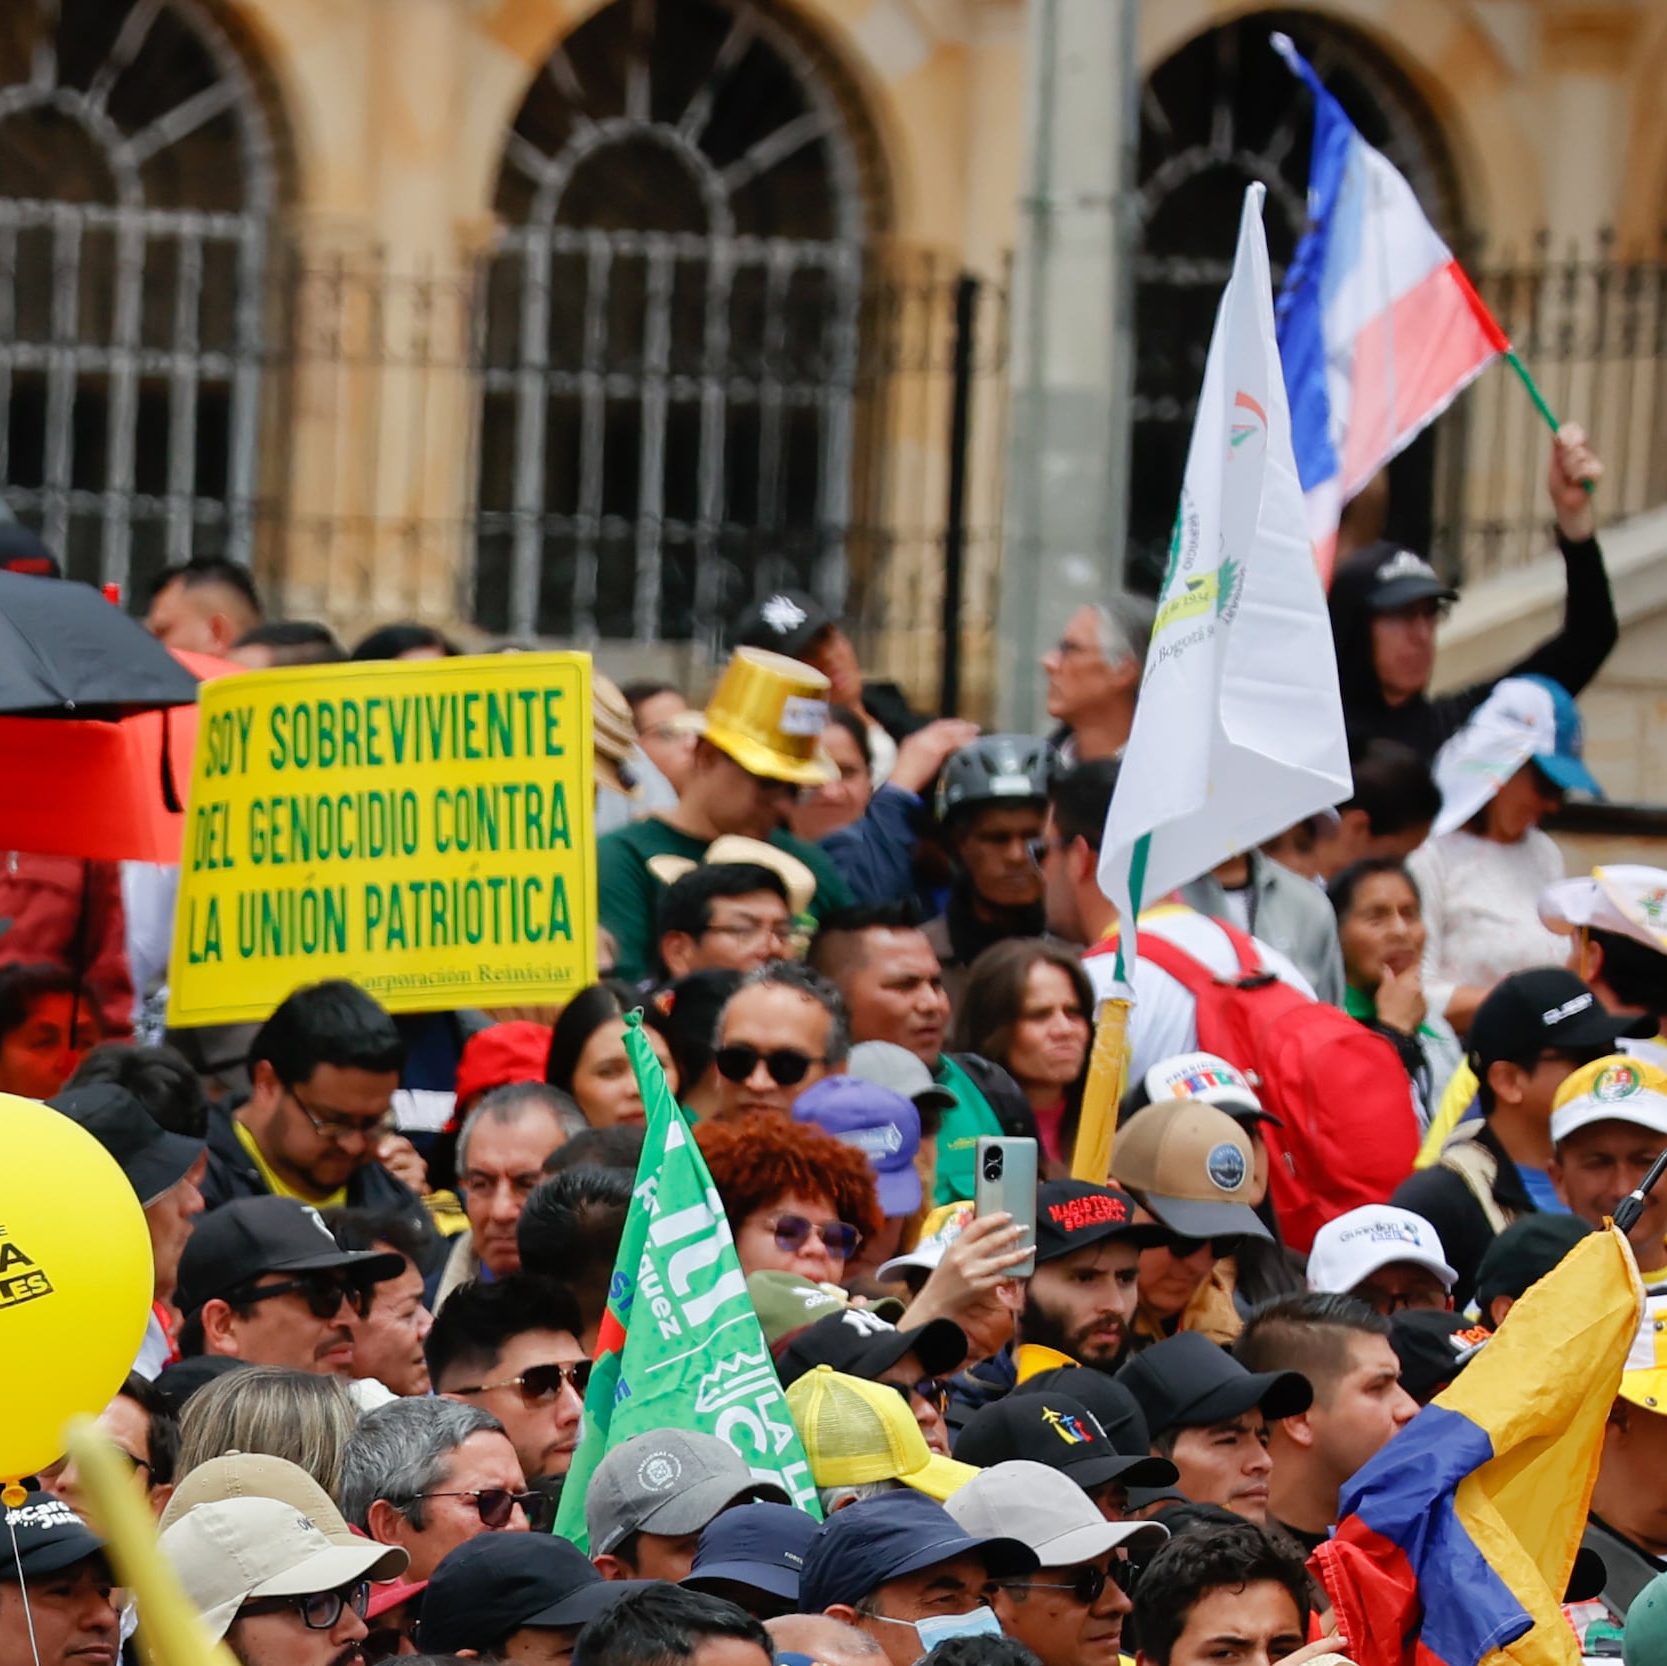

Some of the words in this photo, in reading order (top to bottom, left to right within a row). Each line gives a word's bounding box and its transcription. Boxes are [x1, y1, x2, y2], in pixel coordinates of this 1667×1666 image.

[205, 704, 256, 778] SOY
[268, 688, 565, 771] SOBREVIVIENTE
[192, 803, 235, 872] DEL
[249, 788, 419, 867] GENOCIDIO
[434, 780, 573, 856] CONTRA
[188, 895, 222, 965] LA
[238, 871, 348, 959] UNIÓN
[365, 861, 574, 952] PATRIÓTICA
[477, 963, 573, 983] Reiniciar
